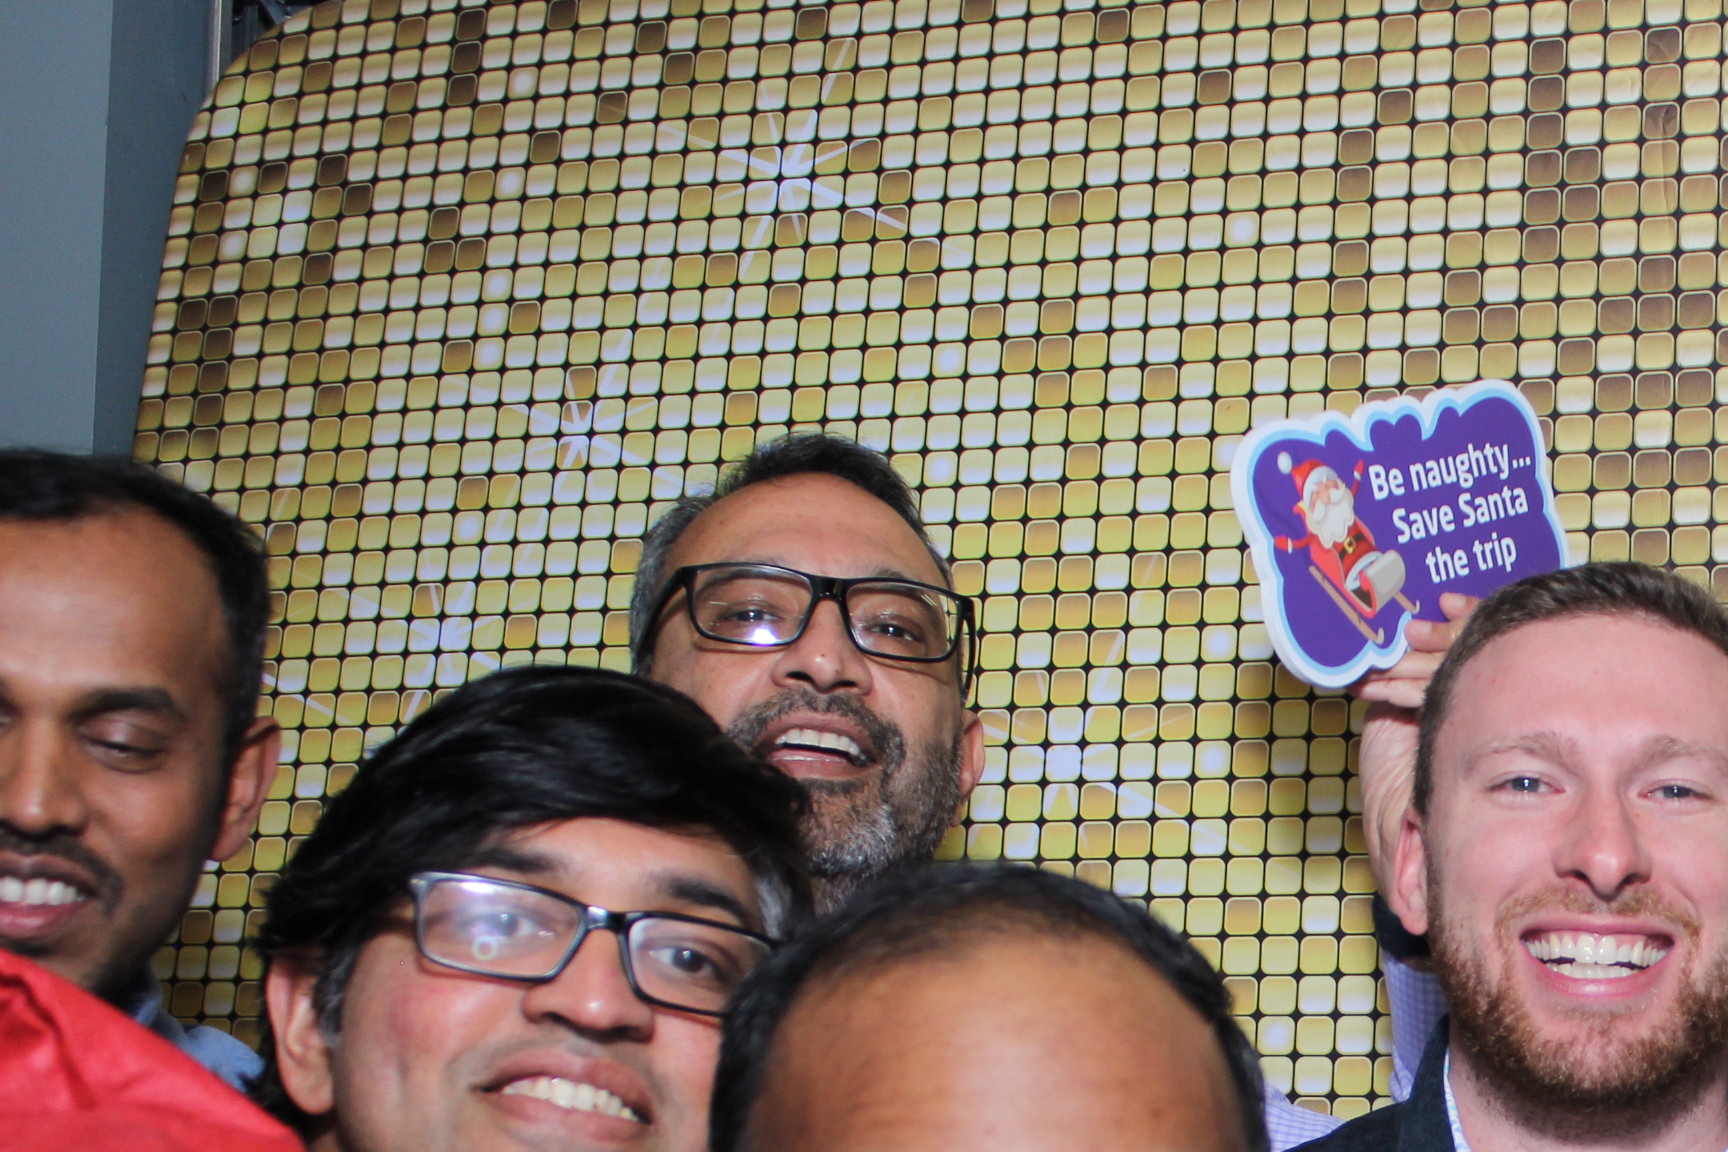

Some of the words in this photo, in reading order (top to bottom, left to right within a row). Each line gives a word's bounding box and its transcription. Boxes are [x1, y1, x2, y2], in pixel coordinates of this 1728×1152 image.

[1368, 464, 1406, 501] Be
[1409, 442, 1532, 489] naughty...
[1392, 507, 1456, 544] Save
[1458, 485, 1529, 528] Santa
[1425, 546, 1470, 584] the
[1472, 531, 1517, 573] trip
